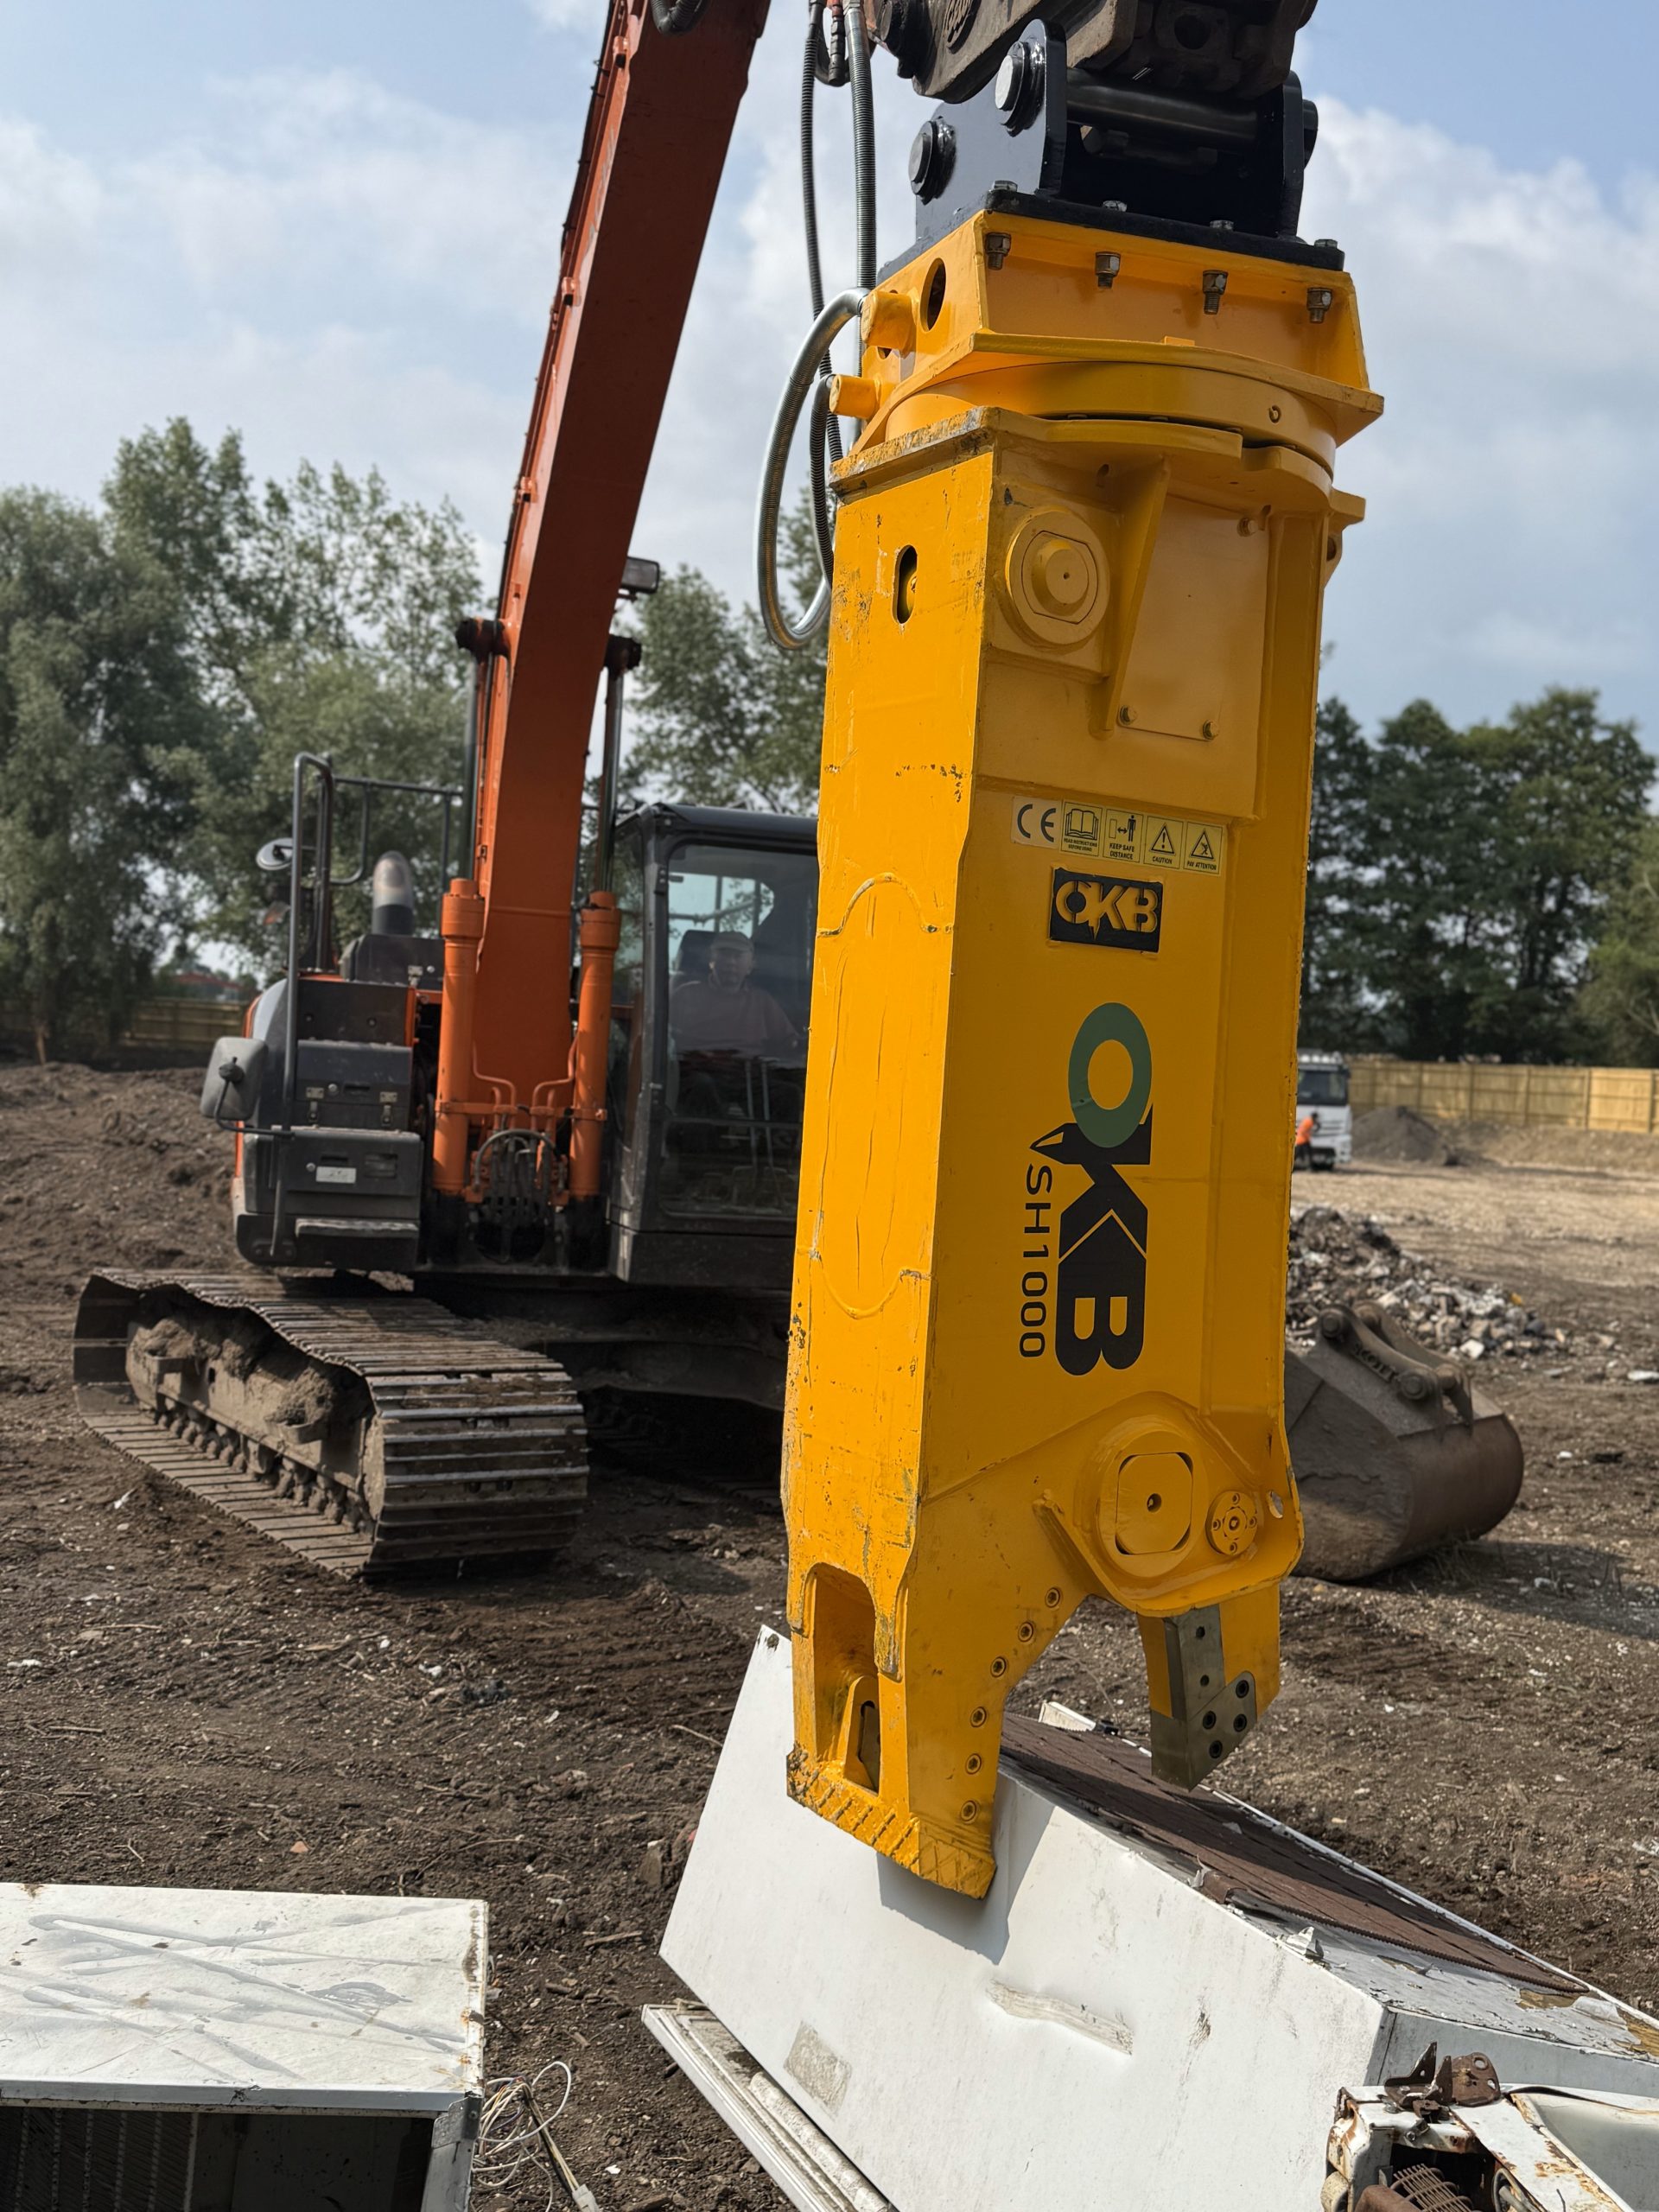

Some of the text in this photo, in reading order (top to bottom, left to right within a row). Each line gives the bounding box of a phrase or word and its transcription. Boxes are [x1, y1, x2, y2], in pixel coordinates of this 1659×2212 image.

[1122, 844, 1135, 853] SAFE
[1109, 849, 1134, 861] DISTANCE
[1152, 855, 1173, 864] CAUTION
[1195, 861, 1217, 871] ATTENTION
[1055, 880, 1159, 939] OKB
[1029, 1001, 1154, 1376] OKB
[1019, 1163, 1052, 1358] SH1000
